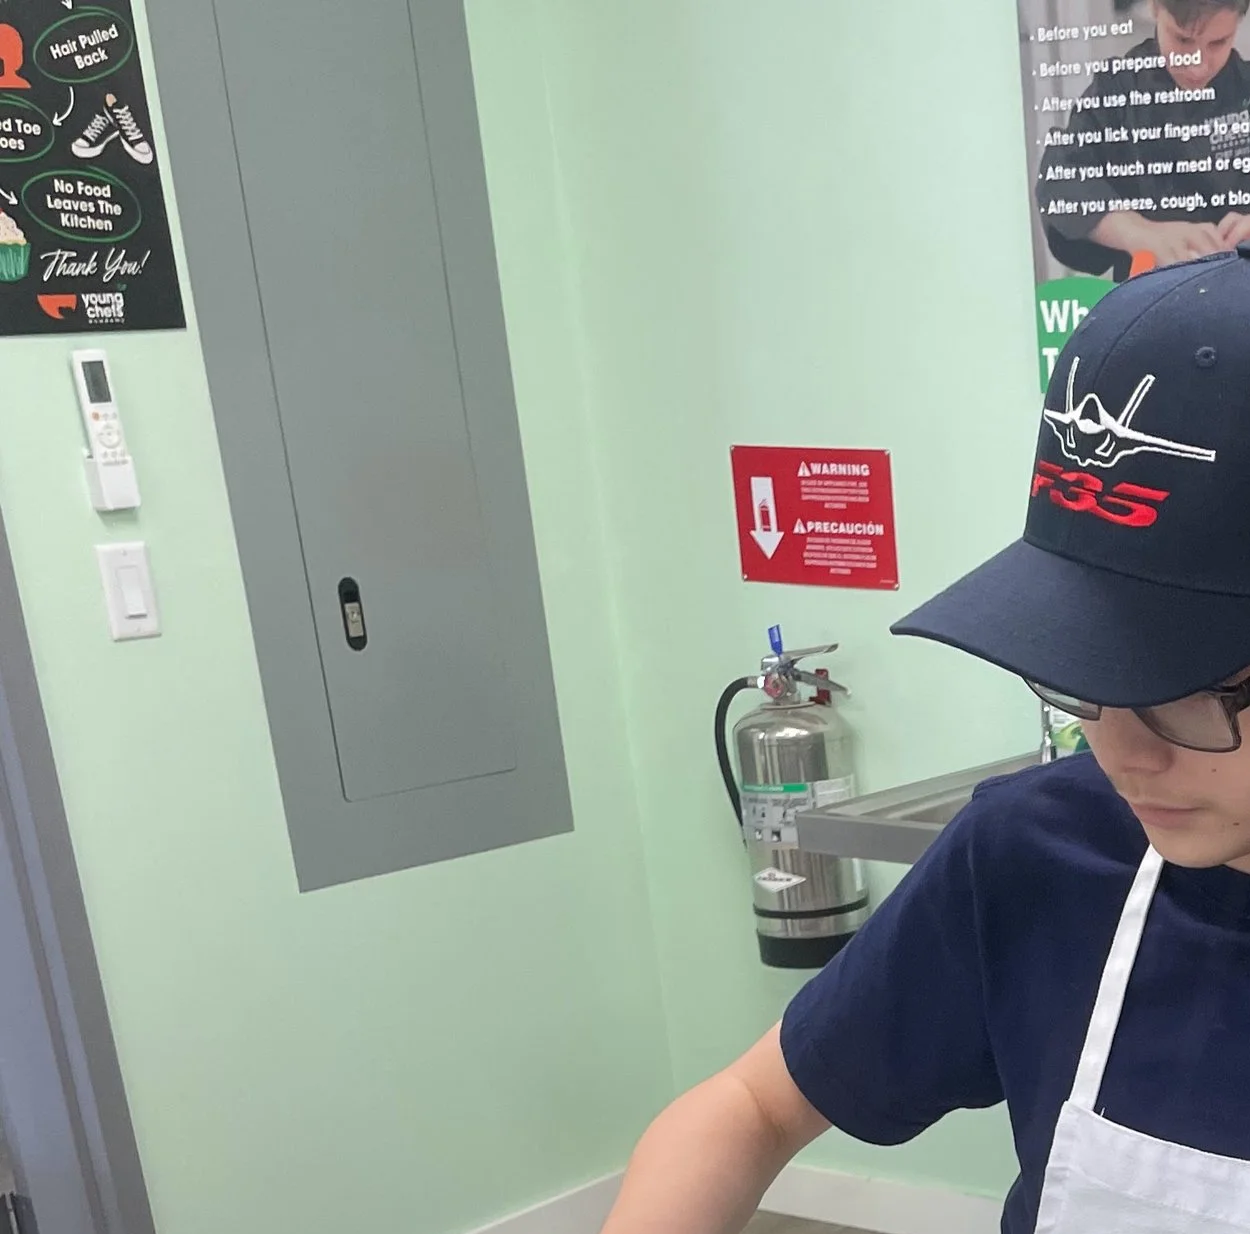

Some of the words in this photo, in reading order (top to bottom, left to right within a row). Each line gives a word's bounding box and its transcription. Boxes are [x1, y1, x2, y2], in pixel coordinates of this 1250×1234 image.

[50, 39, 78, 60] Hair
[78, 23, 119, 49] Pulled
[1037, 25, 1079, 42] Before
[1083, 24, 1107, 41] you
[1111, 20, 1133, 35] eat
[74, 48, 109, 70] Back
[1039, 61, 1081, 77] Before
[1085, 59, 1110, 76] you
[1112, 55, 1166, 74] prepare
[1169, 49, 1202, 66] food
[1042, 97, 1073, 112] After
[1076, 95, 1100, 113] you
[1103, 94, 1127, 107] use
[1130, 90, 1151, 106] the
[1154, 87, 1216, 104] restroom
[0, 117, 12, 132] d
[15, 119, 41, 135] Toe
[1044, 131, 1075, 146] After
[1077, 129, 1102, 147] you
[1105, 126, 1129, 142] lick
[1132, 125, 1162, 143] your
[1164, 122, 1211, 142] fingers
[1213, 119, 1228, 135] to
[1046, 164, 1076, 181] After
[1079, 164, 1103, 182] you
[1106, 159, 1145, 177] touch
[1148, 160, 1173, 175] raw
[1176, 156, 1212, 172] meat
[1215, 158, 1230, 171] or
[54, 178, 74, 194] No
[77, 181, 111, 198] Food
[46, 194, 95, 214] Leaves
[97, 200, 123, 216] The
[1048, 199, 1078, 215] After
[1081, 199, 1105, 216] you
[1108, 196, 1157, 211] sneeze,
[1161, 193, 1208, 212] cough,
[1211, 194, 1225, 206] or
[60, 212, 113, 232] Kitchen
[40, 249, 98, 282] Thank
[102, 247, 151, 283] You!
[81, 291, 124, 309] young
[86, 304, 124, 318] chefs
[810, 462, 871, 477] WARNING
[1031, 459, 1170, 528] F35
[806, 520, 884, 536] PRECAUCIÓN
